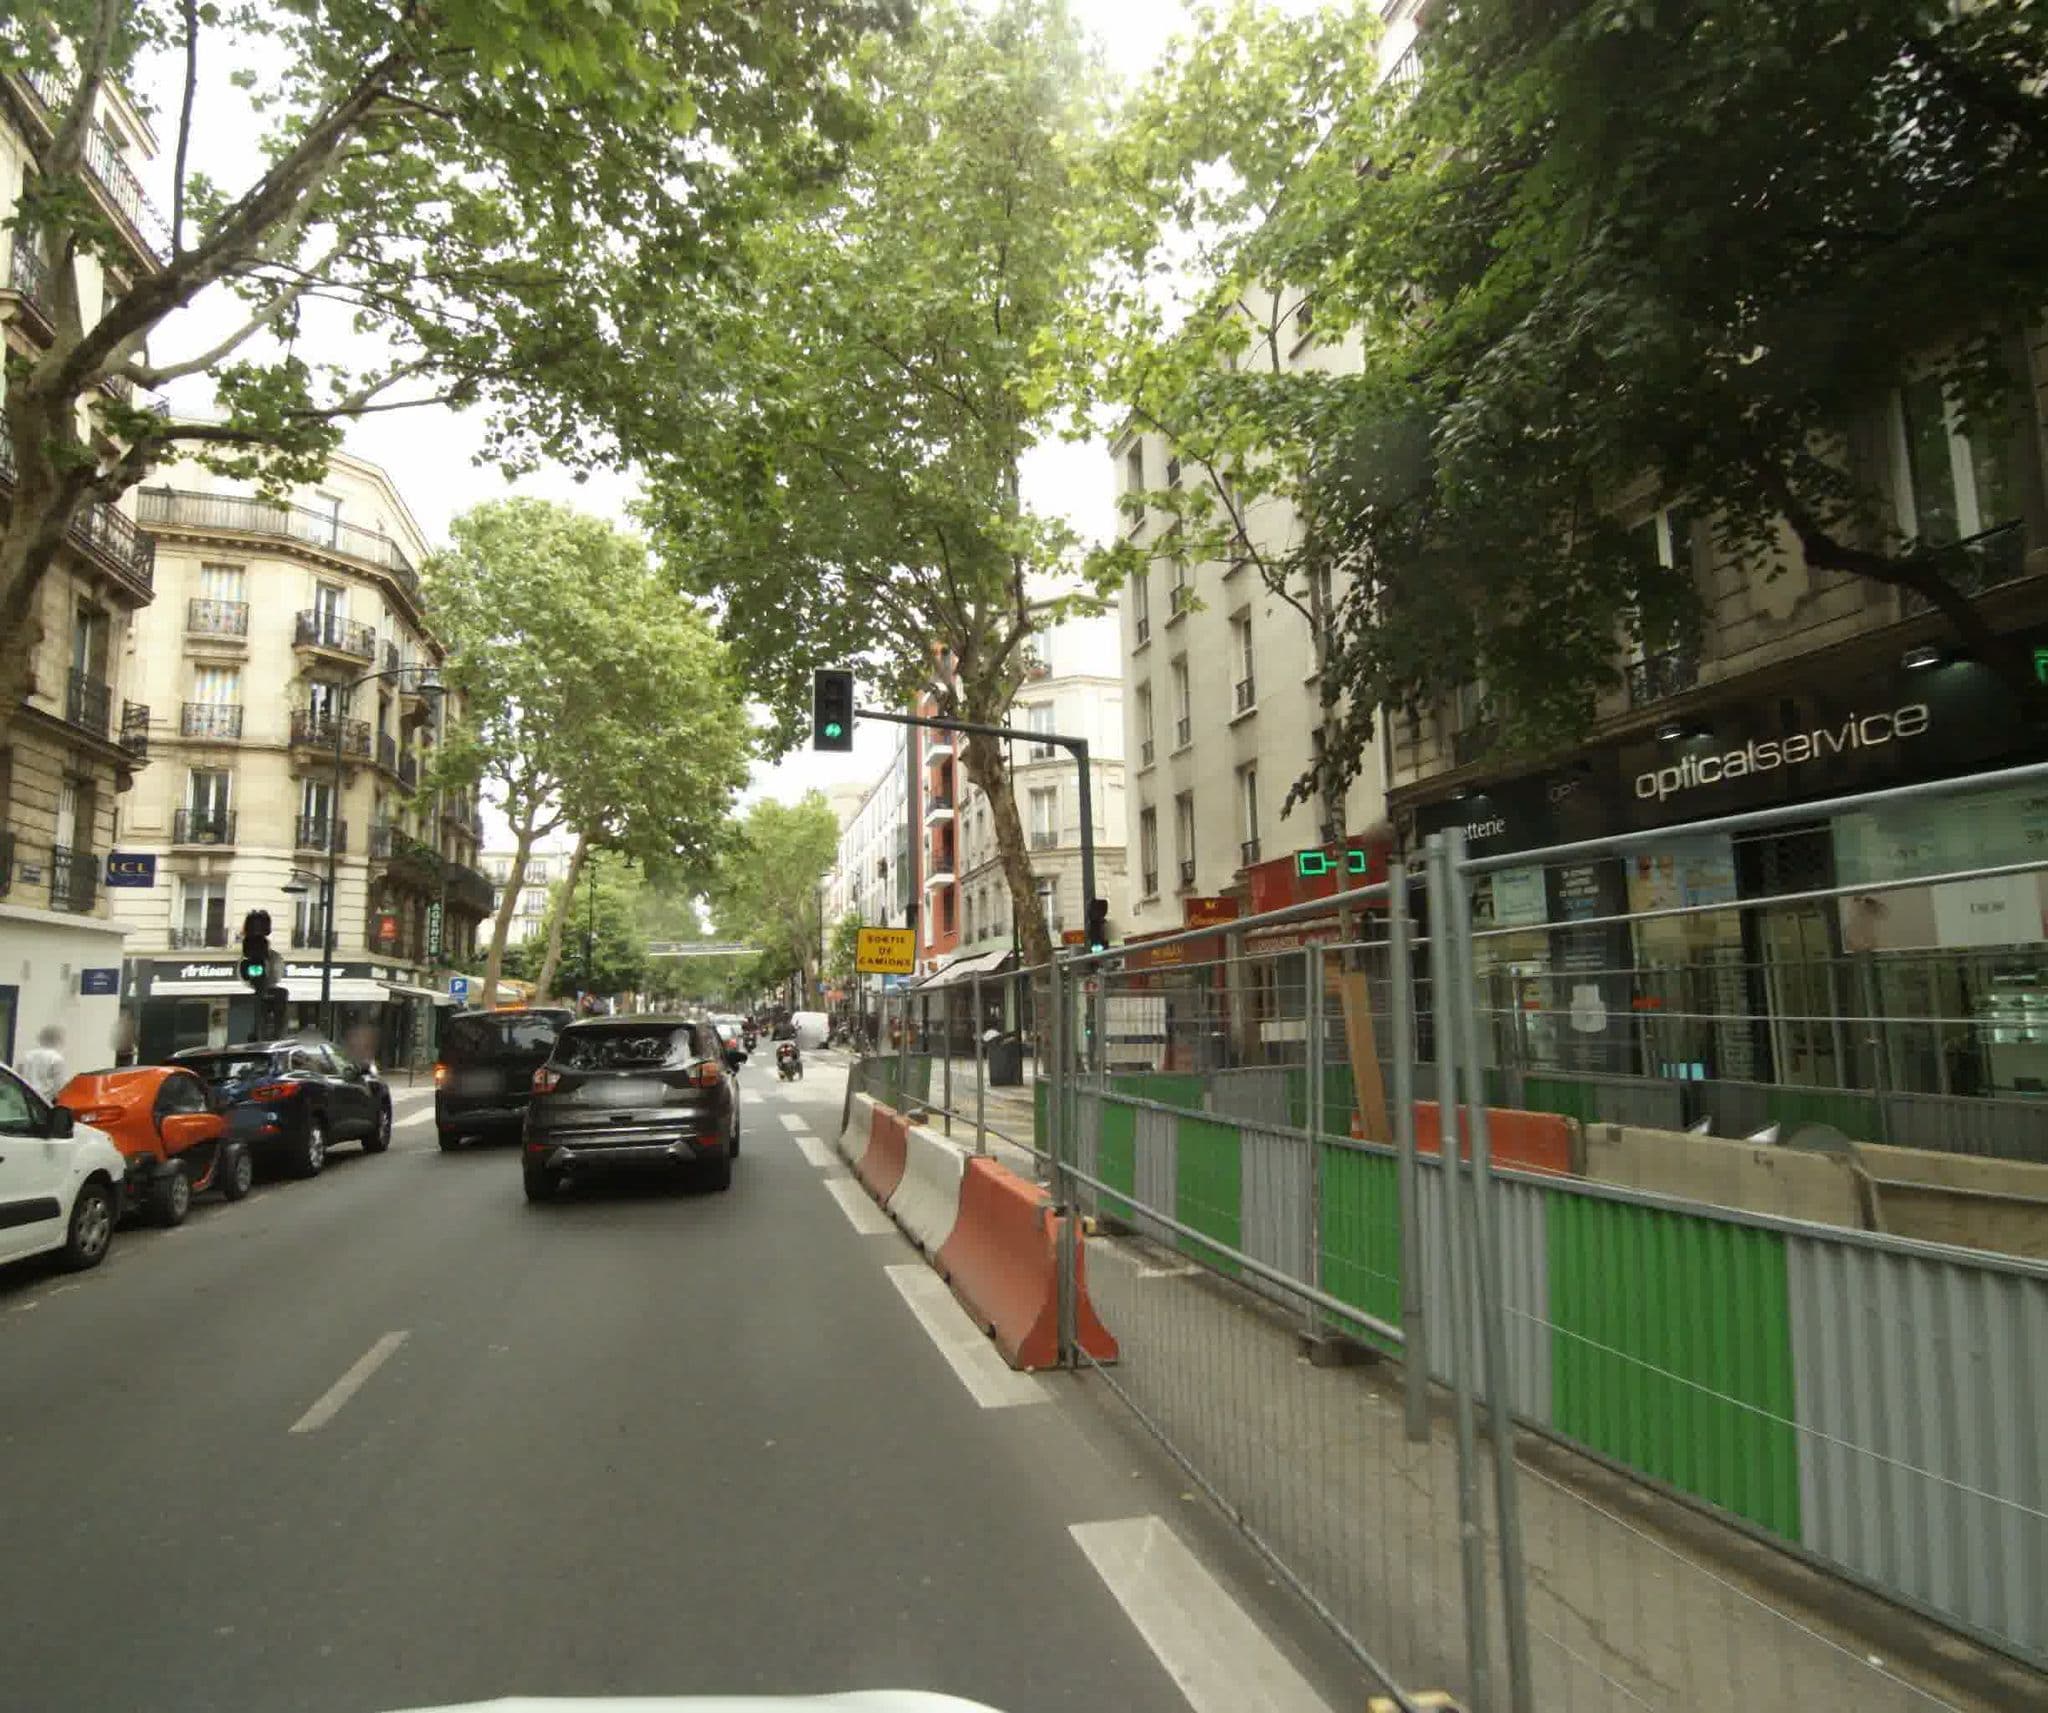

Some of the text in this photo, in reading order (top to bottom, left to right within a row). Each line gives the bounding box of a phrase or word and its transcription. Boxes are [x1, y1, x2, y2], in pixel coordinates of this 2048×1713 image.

[1635, 703, 1929, 801] opticalservice
[430, 903, 441, 954] AGENCE
[859, 957, 911, 968] CAMIONS
